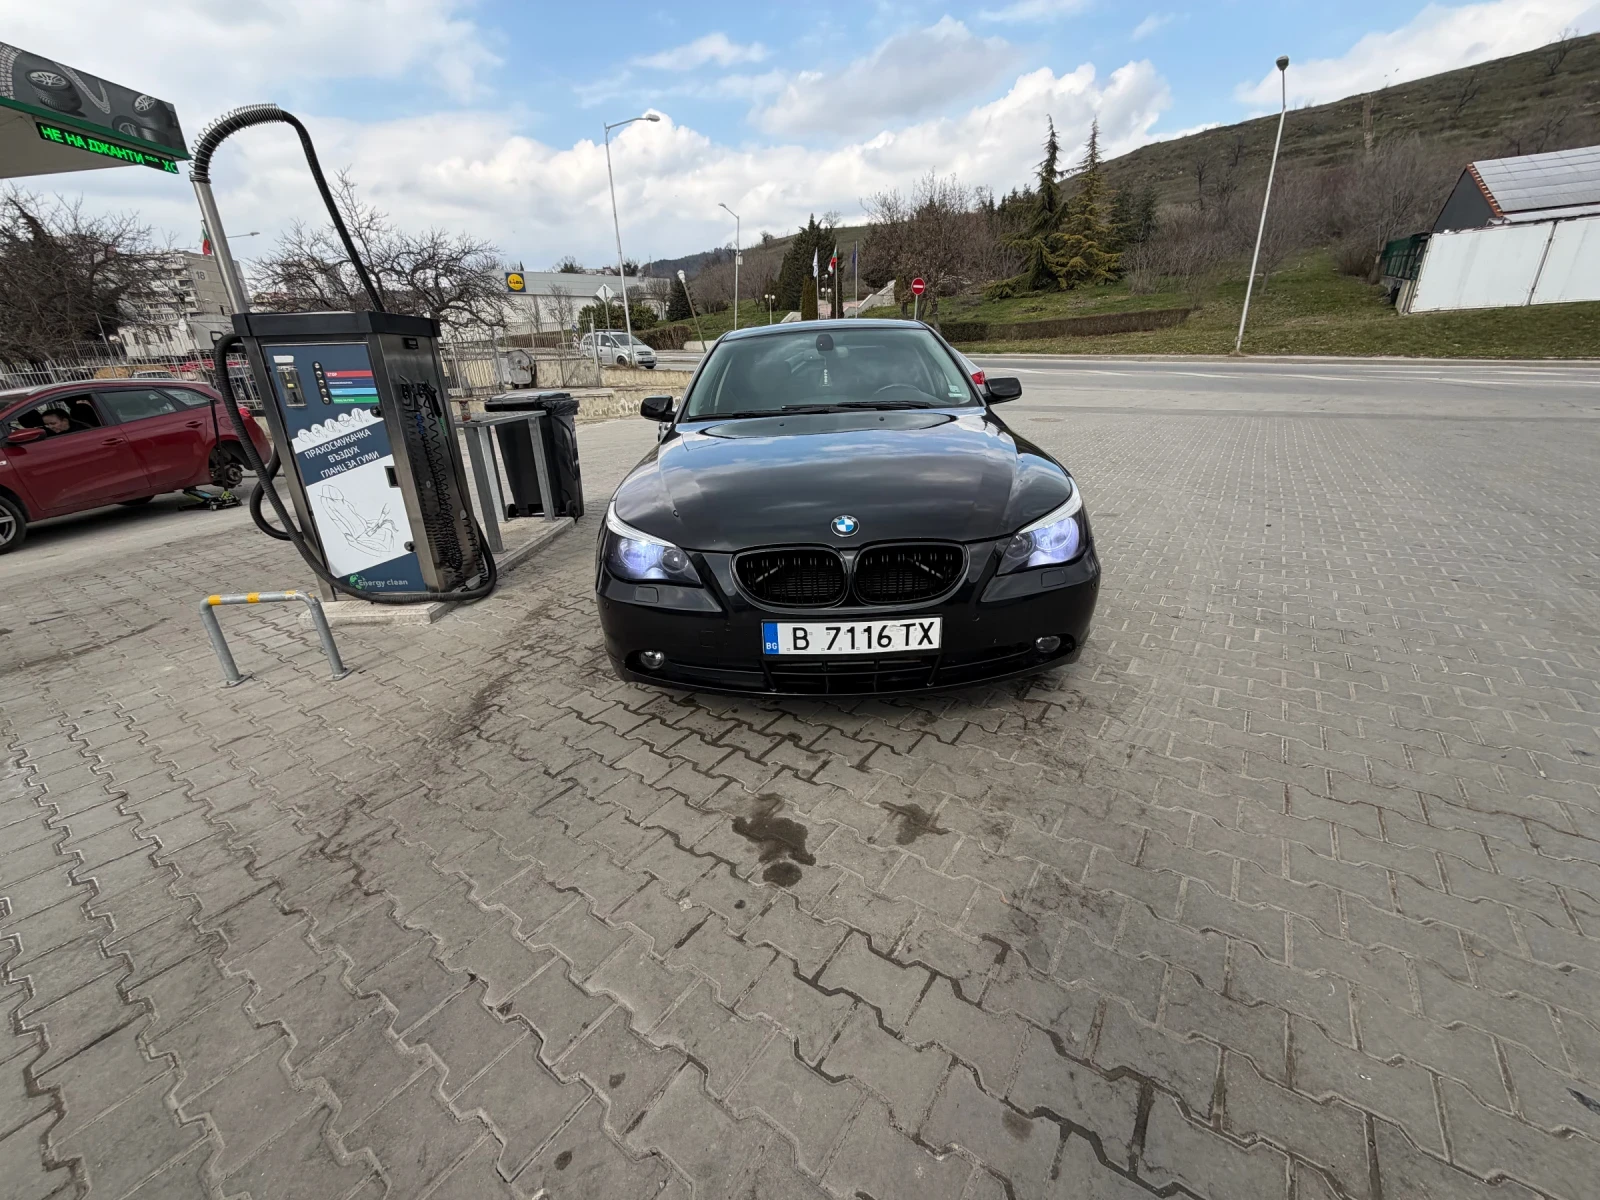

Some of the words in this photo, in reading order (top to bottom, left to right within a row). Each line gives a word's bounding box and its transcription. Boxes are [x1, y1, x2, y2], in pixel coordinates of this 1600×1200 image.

[40, 125, 64, 143] НЕ
[64, 132, 87, 149] НА
[87, 138, 145, 165] ДЖАНТИ
[304, 428, 372, 459] ПРАХОСМУКАЧКА
[328, 445, 360, 463] ВЪЗДУХ
[320, 463, 348, 478] ГЛАНЦ
[345, 459, 358, 469] ЗА
[356, 450, 380, 465] ГУМИ
[357, 579, 385, 588] Energy
[766, 642, 778, 650] BG
[792, 627, 810, 651] B
[825, 625, 893, 651] 7116
[900, 621, 935, 647] TX
